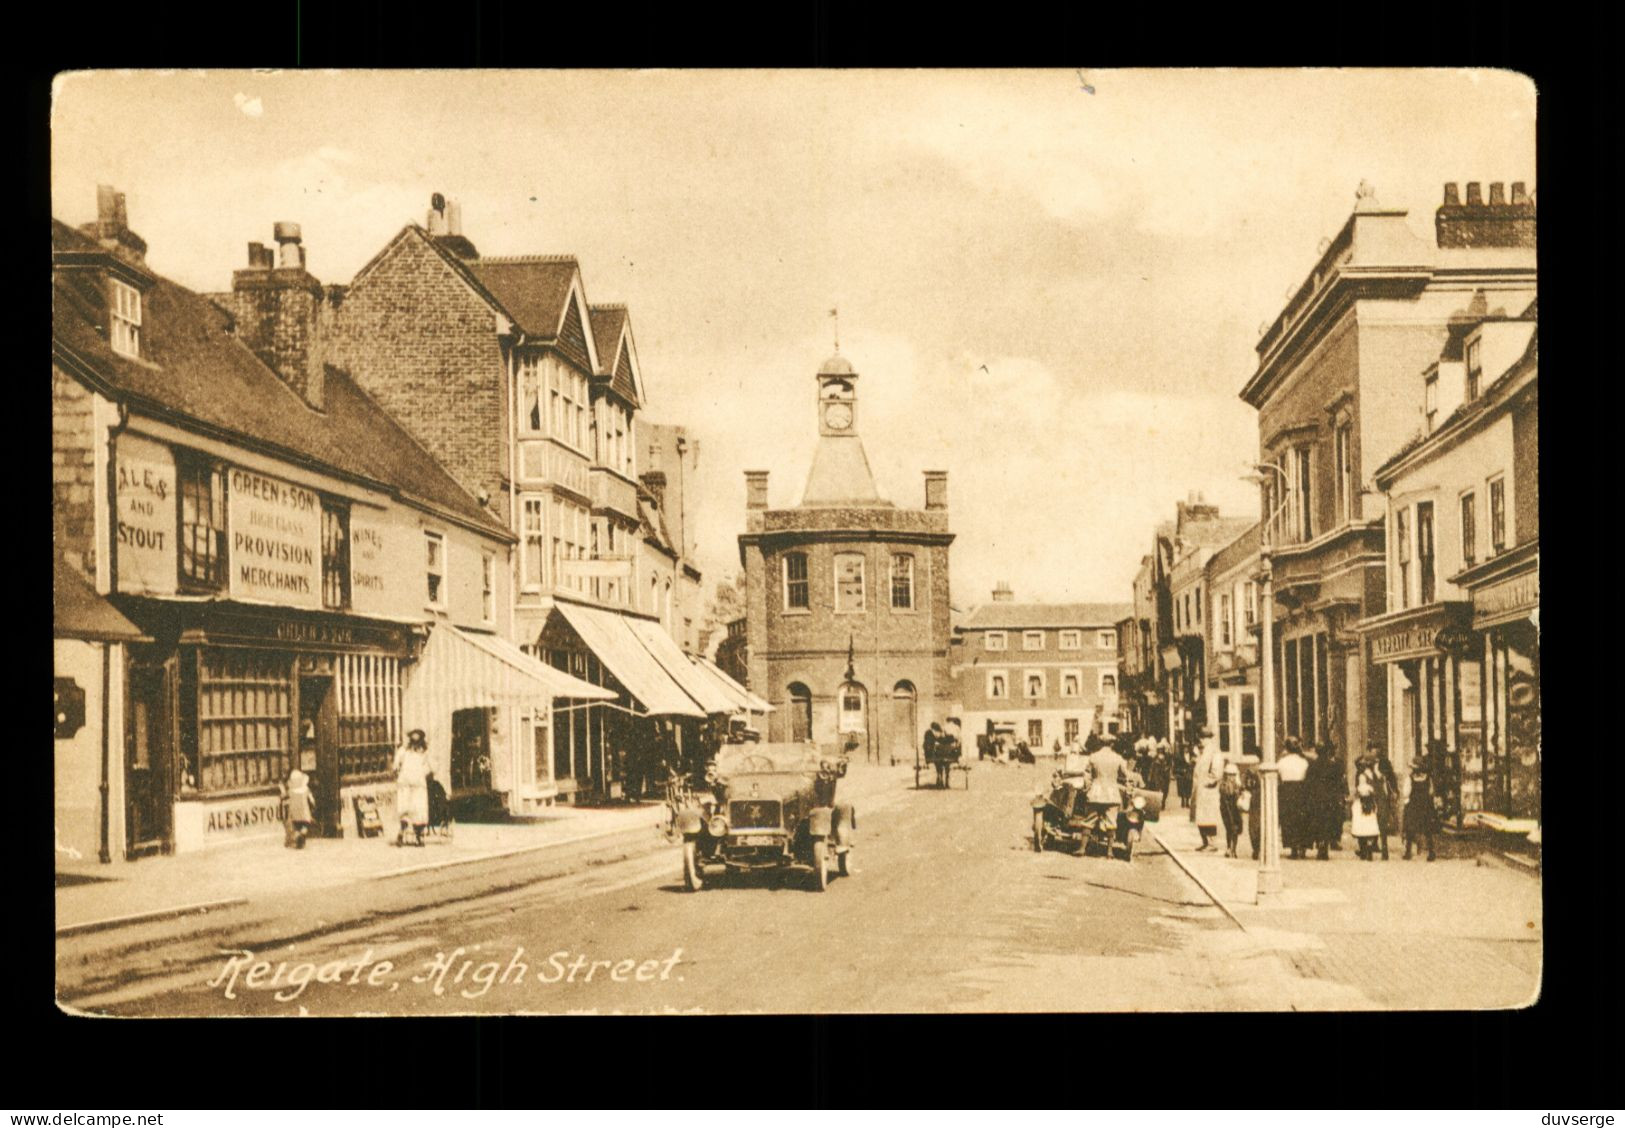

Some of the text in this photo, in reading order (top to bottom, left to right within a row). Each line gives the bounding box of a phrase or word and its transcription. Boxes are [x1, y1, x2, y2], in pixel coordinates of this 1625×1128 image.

[233, 471, 279, 501] GREEN
[290, 487, 314, 511] SON
[130, 499, 154, 516] AND
[118, 521, 164, 551] STOUT
[235, 532, 312, 565] PROVISION
[241, 565, 310, 594] MERCHANTS
[207, 808, 244, 833] ALES
